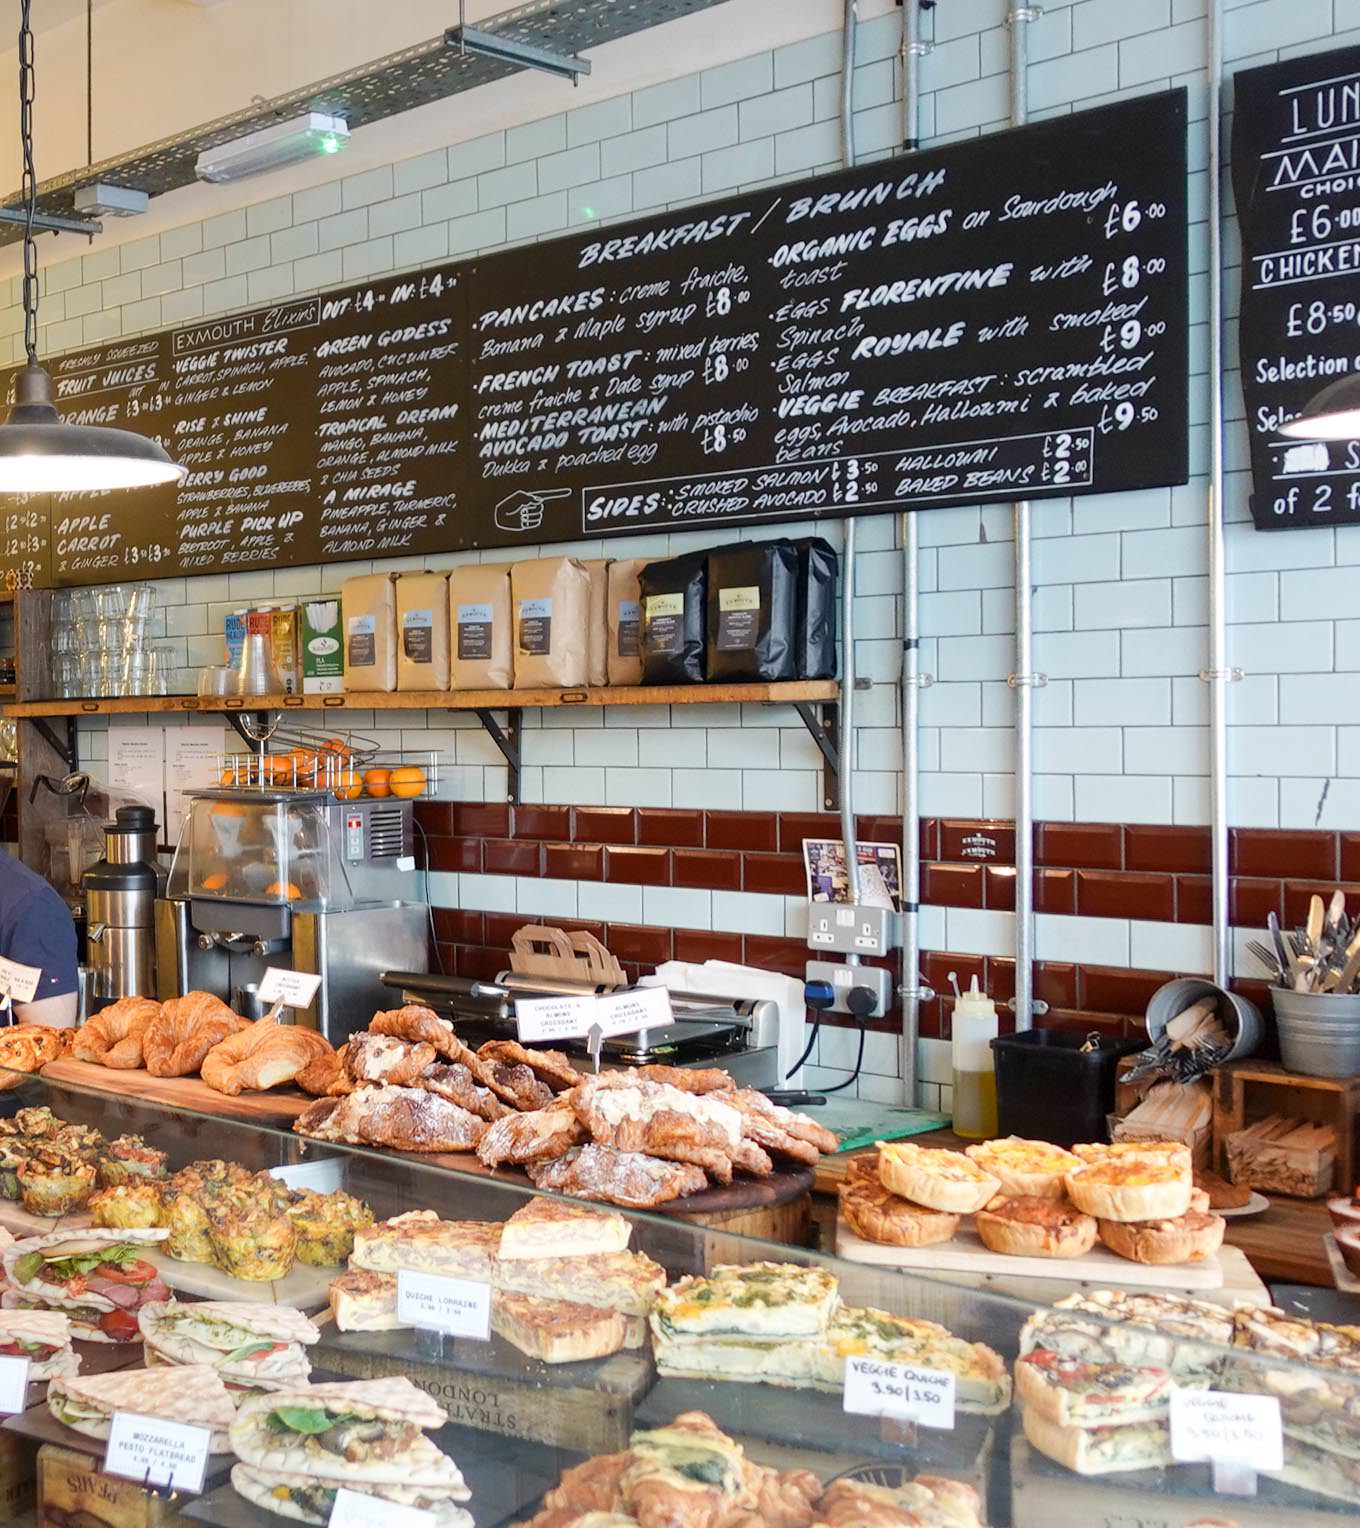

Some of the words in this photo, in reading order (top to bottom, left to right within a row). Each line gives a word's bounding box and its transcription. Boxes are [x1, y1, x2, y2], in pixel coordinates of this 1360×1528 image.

[578, 212, 751, 268] BREAKFAST
[786, 168, 945, 223] BRUNCH
[772, 227, 877, 268] ORGANIC
[881, 209, 952, 247] EGGS
[962, 206, 991, 231] on
[998, 180, 1117, 222] Sourdough
[775, 298, 829, 322] EGGS
[840, 262, 1014, 314] FLORENTINE
[1030, 254, 1094, 282] with
[780, 261, 848, 289] toast
[177, 318, 255, 349] EXMOUTH
[317, 335, 369, 357] GREEN
[378, 318, 452, 347] GODESS
[574, 314, 625, 341] Maple
[635, 302, 697, 333] syrup
[775, 348, 839, 371] EGGS
[851, 321, 965, 361] ROYALE
[977, 315, 1030, 343] with
[1049, 296, 1149, 331] smoked
[776, 316, 866, 349] Spinach
[176, 352, 217, 374] VEGGIE
[224, 339, 288, 363] TWISTER
[478, 365, 559, 394] FRENCH
[656, 337, 702, 363] mixed
[1256, 354, 1348, 383] Selection
[57, 375, 96, 397] FRUIT
[103, 363, 157, 387] JUICES
[478, 402, 523, 420] creme
[529, 386, 582, 413] fraiche
[605, 375, 642, 398] Date
[649, 368, 695, 393] syrup
[777, 371, 850, 394] Salmon
[777, 389, 865, 419] VEGGIE
[1013, 350, 1154, 388] scrambled
[320, 397, 363, 413] LEMON
[921, 396, 1031, 427] Halloumi
[1069, 376, 1156, 406] baked
[176, 417, 205, 434] RISE
[224, 408, 268, 425] SHINE
[234, 423, 288, 442] BANANA
[319, 416, 387, 437] TROPICAL
[396, 406, 458, 425] DREAM
[478, 431, 570, 457] AVOCADO
[657, 413, 688, 434] with
[691, 402, 759, 434] pistachio
[479, 396, 668, 442] MEDITERRANEAN
[482, 459, 531, 479] Dukka
[555, 445, 627, 472] poached
[627, 442, 658, 465] egg
[775, 440, 843, 463] beans
[229, 465, 268, 480] GOOD
[362, 465, 400, 478] SEEDS
[674, 477, 747, 500] SMOKED
[752, 466, 830, 492] SALMON
[895, 447, 998, 473] HALLOUMI
[343, 481, 417, 501] MIRAGE
[671, 496, 749, 518] CRUSHED
[752, 488, 827, 507] AVOCADO
[895, 474, 957, 497] BAKED
[963, 465, 1035, 488] BEANS
[1274, 487, 1299, 514] of
[1312, 485, 1332, 512] 2
[58, 514, 112, 535] APPLE
[180, 520, 233, 539] PURPLE
[241, 515, 275, 532] PICK
[279, 512, 303, 528] UP
[57, 534, 121, 555] CARROT
[321, 538, 374, 552] ALMOND
[378, 534, 411, 548] MILK
[72, 555, 119, 569] GINGER
